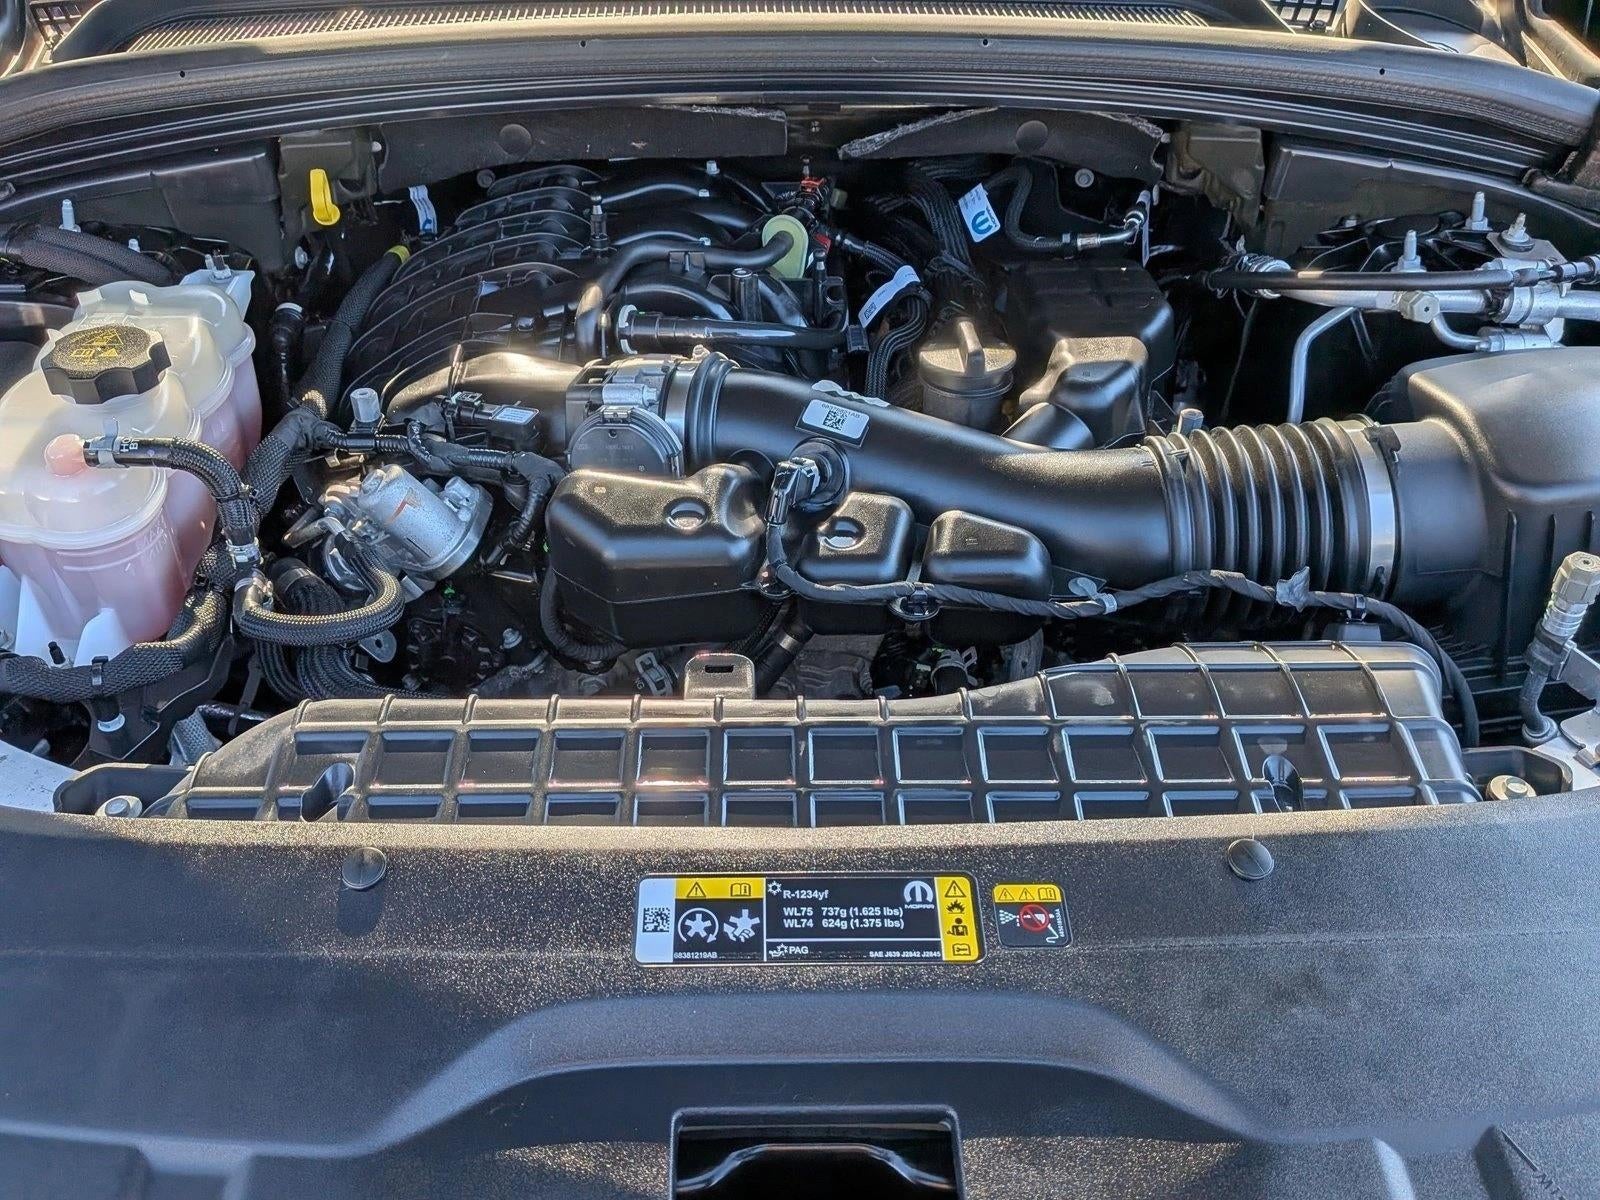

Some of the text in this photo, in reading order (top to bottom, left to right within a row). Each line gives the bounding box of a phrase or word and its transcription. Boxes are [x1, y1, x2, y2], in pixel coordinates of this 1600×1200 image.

[783, 890, 829, 901] R-1234yf
[783, 906, 904, 918] WL75 737g (1.625 lbs)
[783, 918, 905, 929] WL74 624g (1.375 lbs)
[788, 946, 809, 954] PAG
